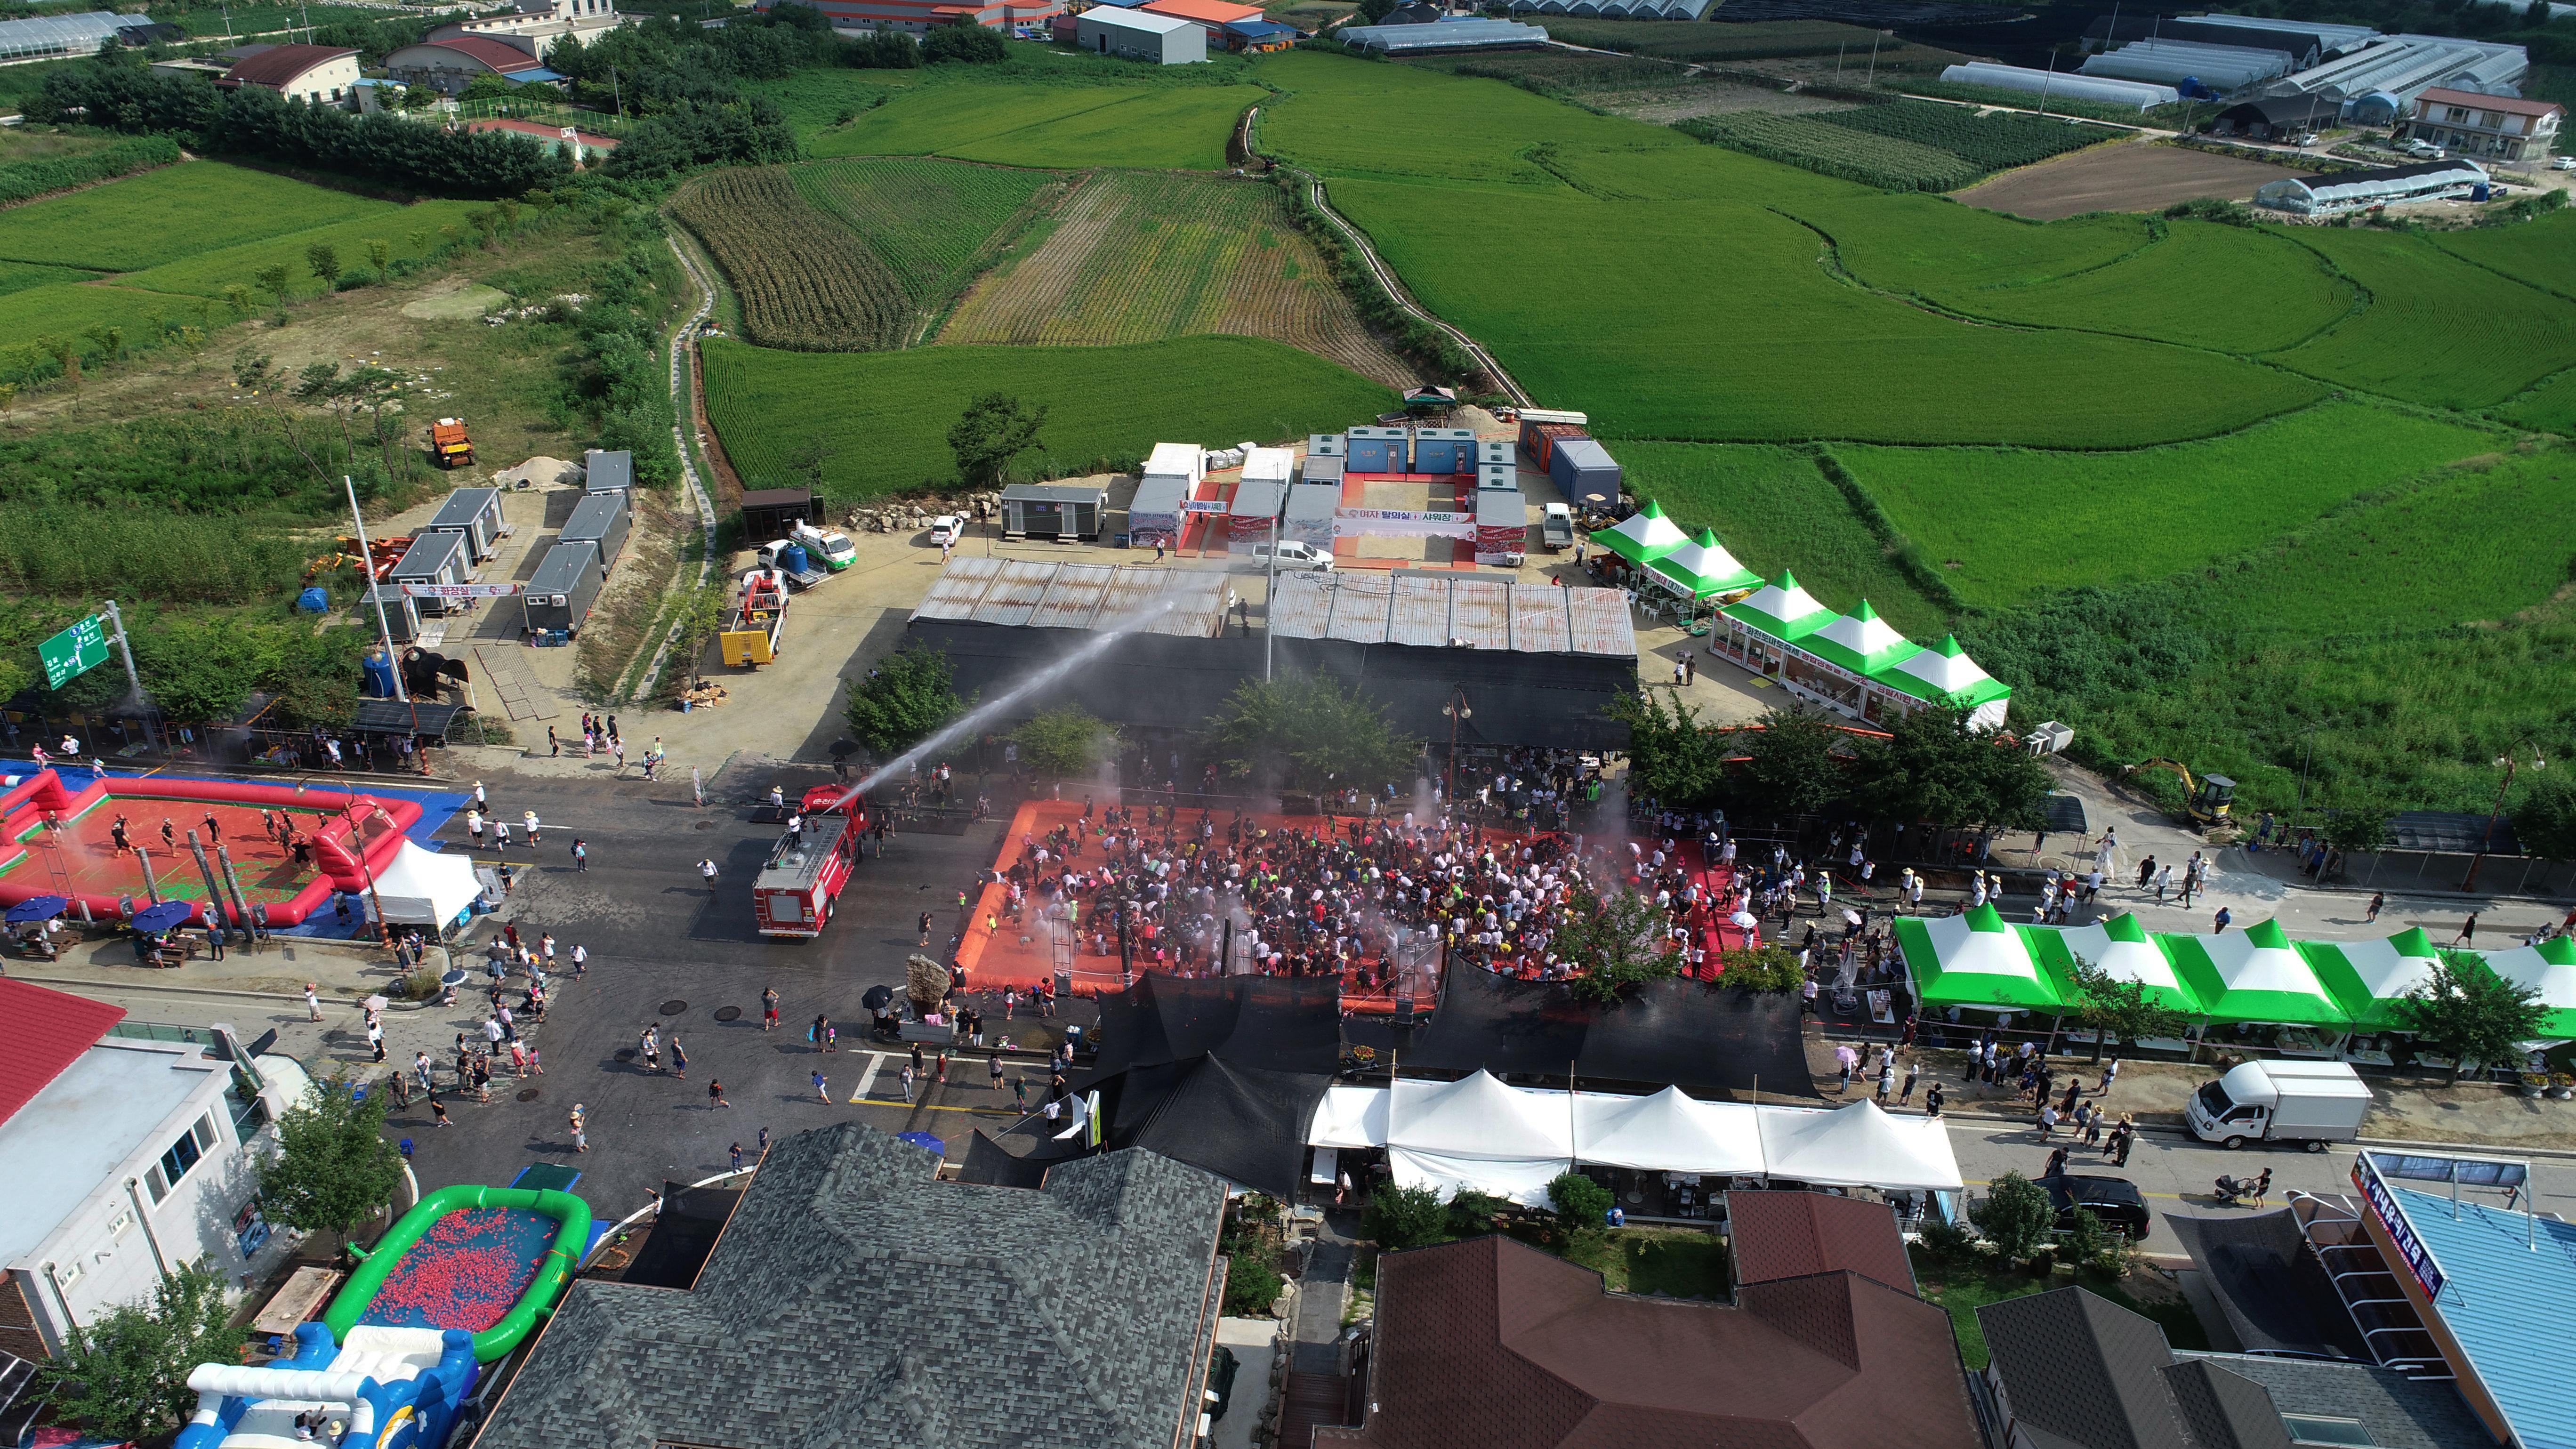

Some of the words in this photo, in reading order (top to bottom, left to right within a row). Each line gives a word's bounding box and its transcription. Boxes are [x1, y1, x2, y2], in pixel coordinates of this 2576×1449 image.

[1196, 502, 1207, 510] 탈의실
[1211, 502, 1222, 511] 샤워장
[1360, 510, 1379, 518] 여자
[1382, 511, 1410, 520] 탈의실
[1422, 513, 1452, 522] 샤워장
[1650, 570, 1668, 586] 기동대
[1667, 580, 1685, 596] 대기소
[440, 586, 469, 596] 화장실
[1746, 625, 1800, 656] 화천토마토축제
